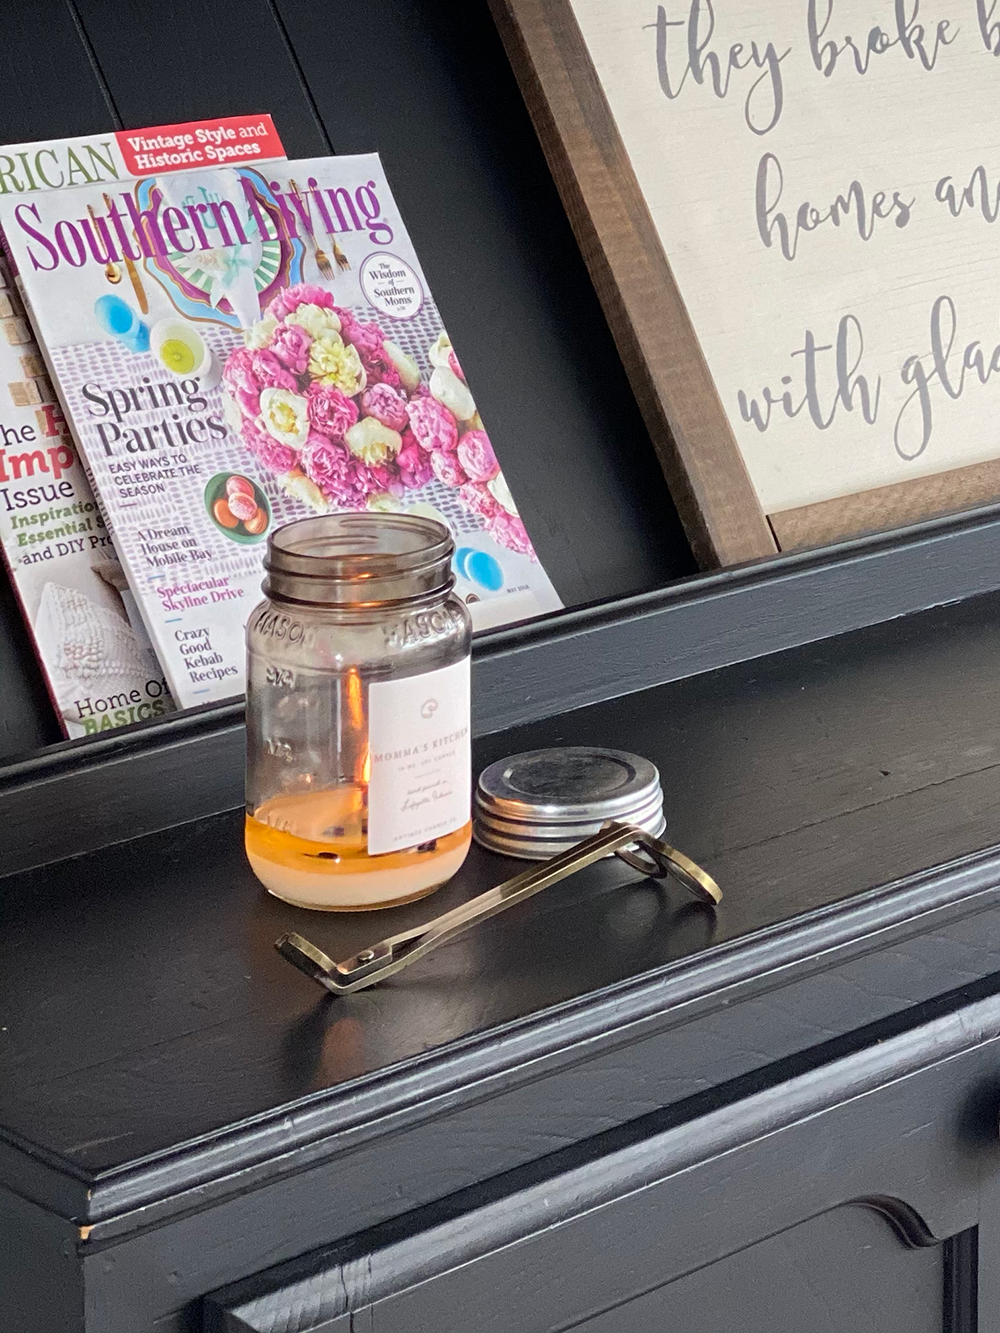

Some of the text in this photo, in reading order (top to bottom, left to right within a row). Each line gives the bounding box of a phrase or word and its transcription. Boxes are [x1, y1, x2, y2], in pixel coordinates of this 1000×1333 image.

[126, 123, 268, 152] Vintage Style and
[134, 142, 262, 169] Historic Spaces
[755, 152, 916, 262] homes
[14, 192, 252, 271] Southern
[237, 176, 394, 245] Living
[369, 269, 407, 280] Wisdom
[373, 286, 415, 298] Southern
[384, 296, 412, 307] Moms
[737, 313, 882, 433] with
[82, 376, 208, 423] Spring
[96, 413, 229, 457] Parties
[109, 453, 188, 474] EASY WAYS TO
[114, 464, 202, 486] CELEBRATE THE
[0, 480, 75, 512] Issue
[118, 482, 166, 498] SEASON
[16, 517, 93, 548] Essential
[138, 525, 191, 541] A Dream
[21, 546, 55, 565] and
[55, 538, 85, 557] DIY
[140, 538, 197, 555] House on
[145, 549, 213, 567] Mobile Bay
[157, 576, 230, 599] Spectacular
[162, 587, 245, 612] Skyline Drive
[174, 627, 211, 643] Crazy
[179, 636, 213, 656] Good
[183, 651, 224, 670] Kebab
[188, 664, 239, 684] Recipes
[74, 689, 142, 719] Home
[82, 699, 166, 736] BASICS
[374, 742, 429, 764] MOMMA'S
